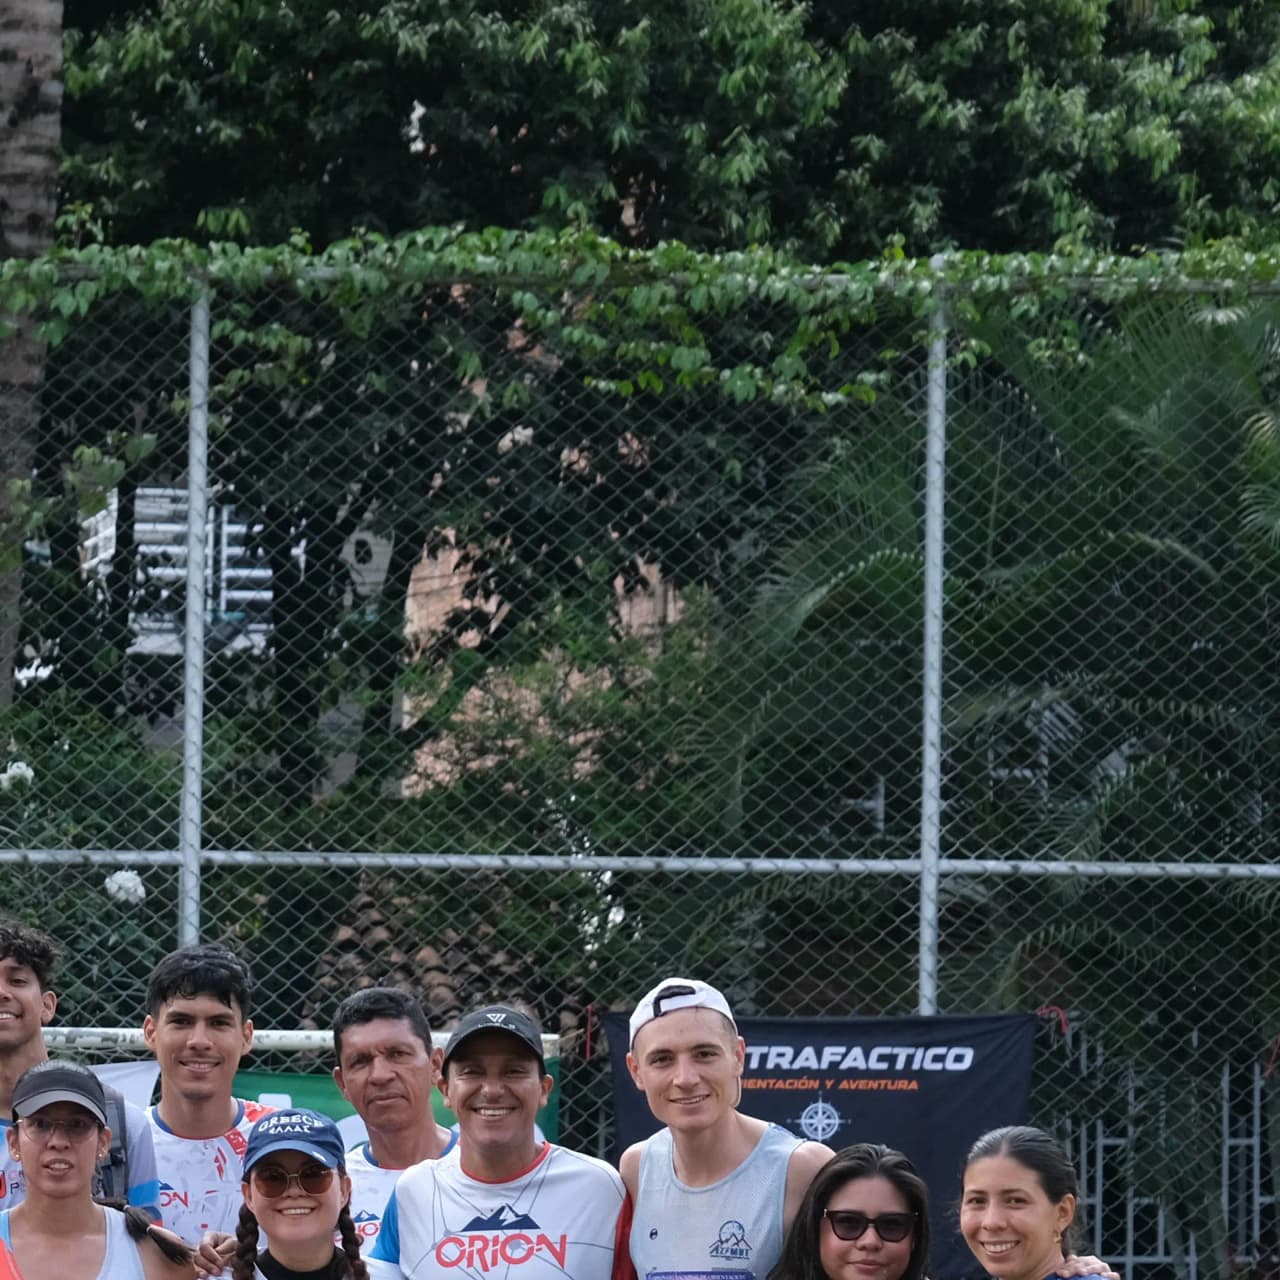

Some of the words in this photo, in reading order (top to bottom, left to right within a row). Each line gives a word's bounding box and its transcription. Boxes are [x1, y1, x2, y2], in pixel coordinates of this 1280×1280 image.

[745, 1046, 974, 1072] TRAFACTICO
[742, 1076, 820, 1090] IENTACIÓN
[825, 1079, 835, 1089] Y
[838, 1079, 919, 1090] AVENTURA
[435, 1233, 568, 1273] ORION
